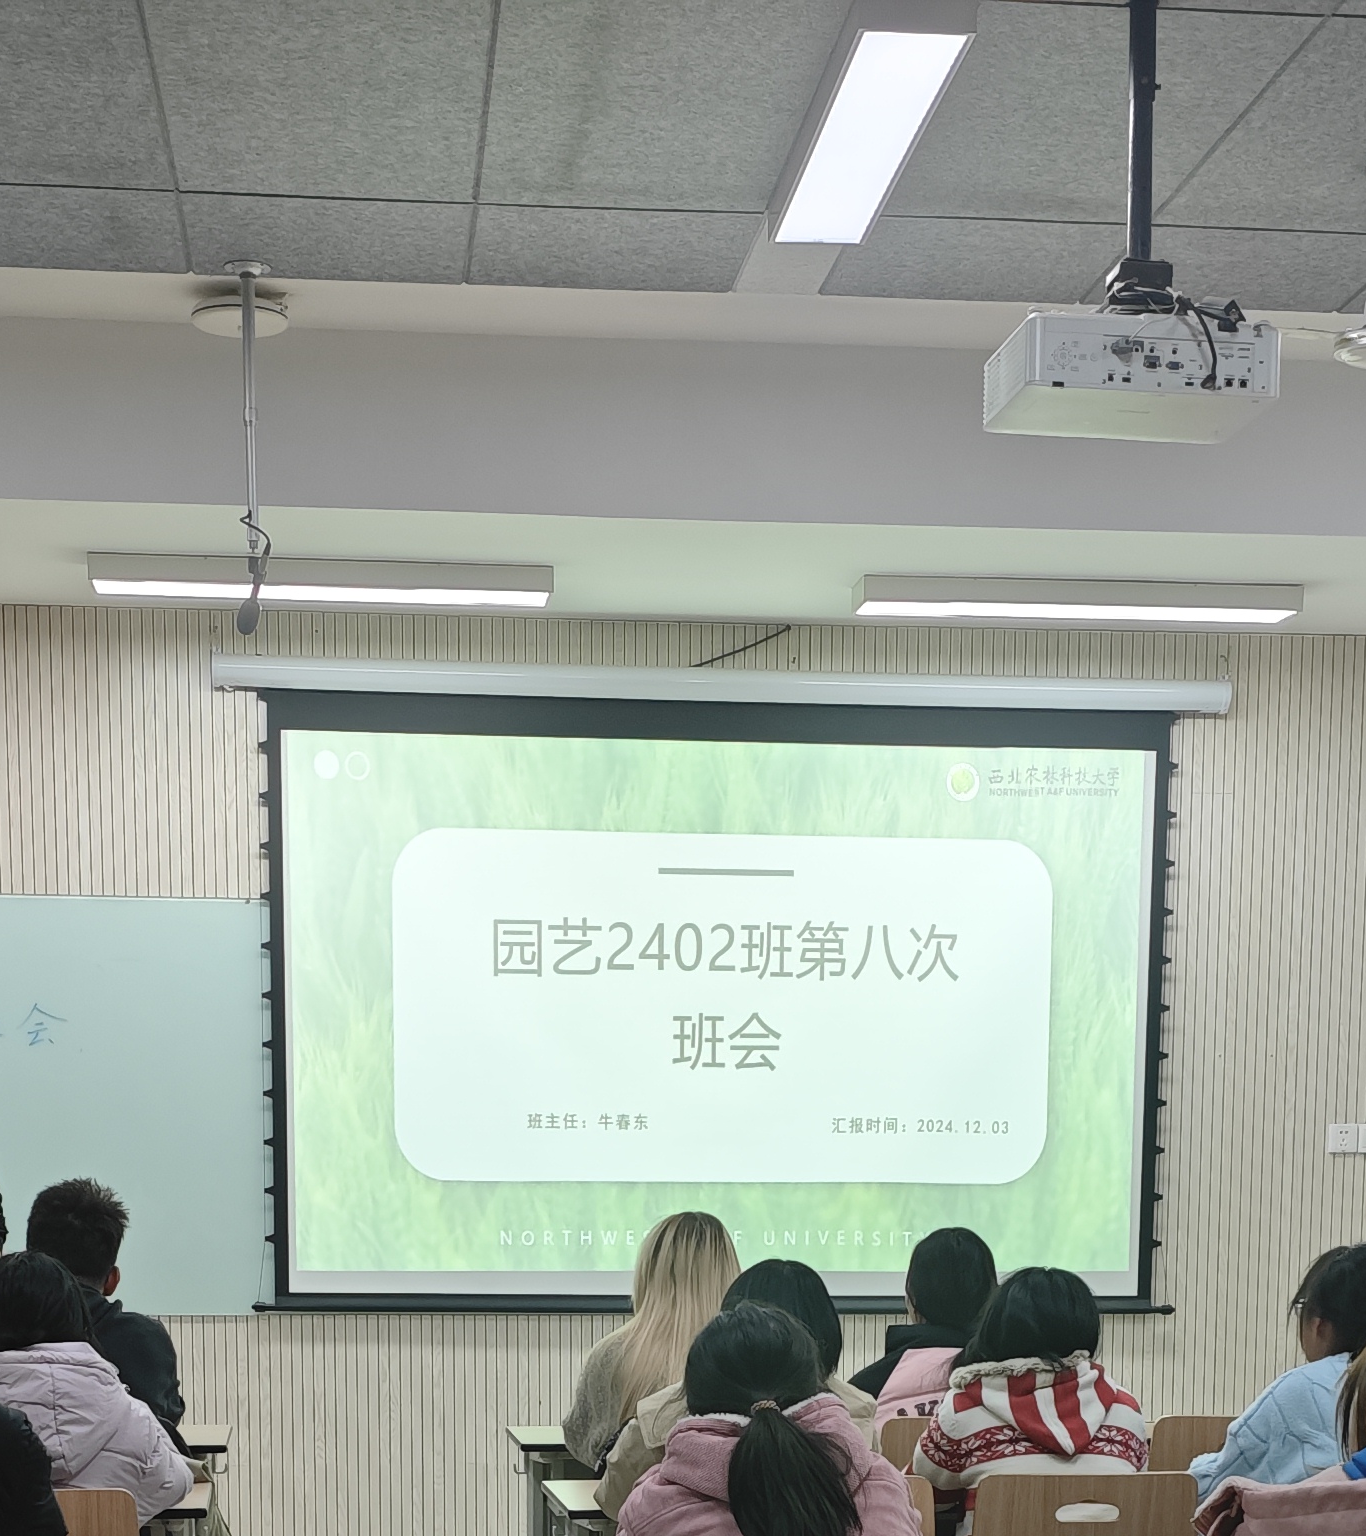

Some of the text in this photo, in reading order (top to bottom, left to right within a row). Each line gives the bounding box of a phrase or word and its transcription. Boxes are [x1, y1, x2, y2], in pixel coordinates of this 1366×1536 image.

[988, 765, 1120, 787] 西北农林科技大学
[988, 787, 1120, 797] NORTHWEST A&F UNIVERSITY
[492, 917, 960, 982] 园艺2402班第八次
[672, 1012, 782, 1071] 班会
[527, 1112, 649, 1130] 班主任：牛春东
[831, 1117, 1011, 1136] 汇报时间：2024.12.03
